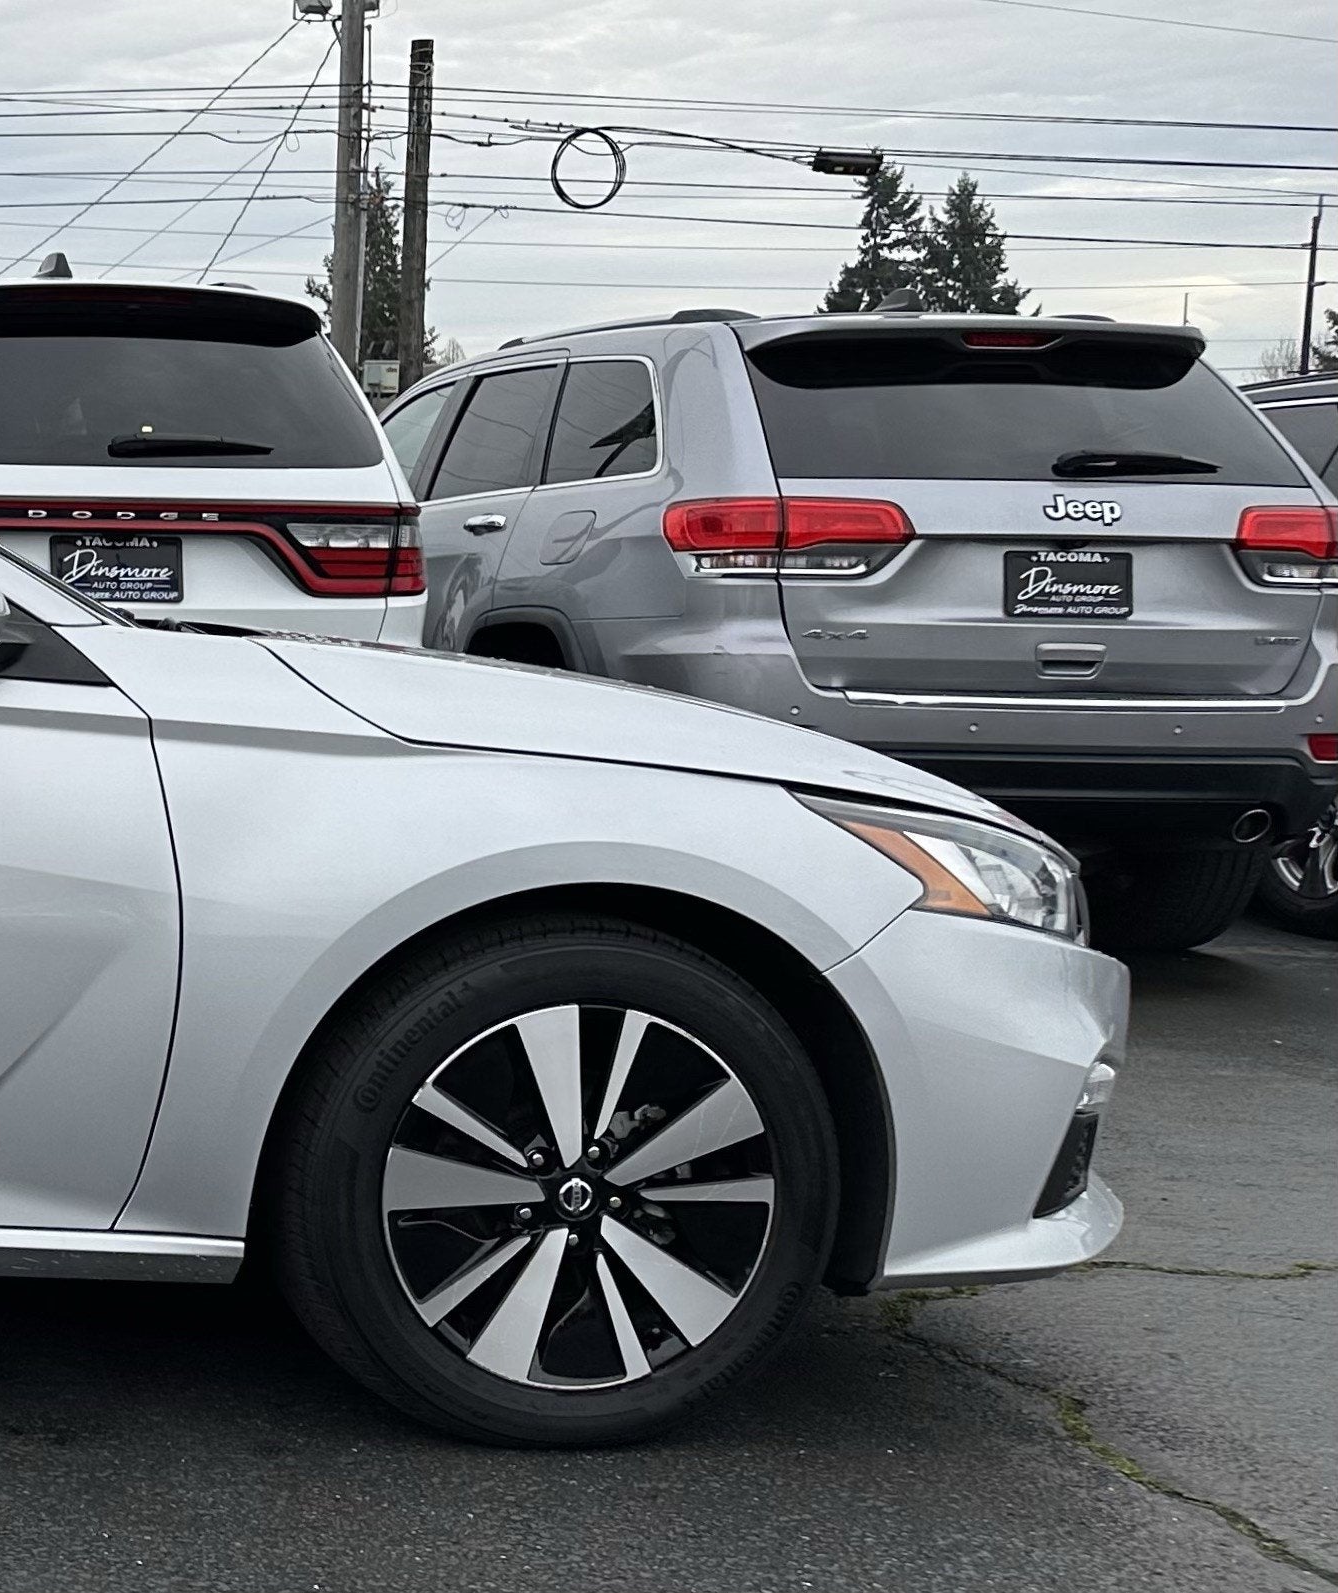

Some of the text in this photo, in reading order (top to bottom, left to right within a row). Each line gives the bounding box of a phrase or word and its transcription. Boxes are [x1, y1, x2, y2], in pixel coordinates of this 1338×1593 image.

[28, 509, 220, 521] DODGE
[1043, 494, 1122, 526] Jeep
[1037, 551, 1103, 563] TACOMA
[63, 549, 173, 584] Dinsmore
[92, 582, 153, 590] AUTO GROUP
[1017, 566, 1123, 600] Dinsmore
[112, 591, 141, 599] AUTO
[143, 591, 179, 600] GROUP
[1066, 605, 1093, 614] AUTO
[1094, 606, 1129, 615] GROUP
[354, 989, 463, 1114] Continental
